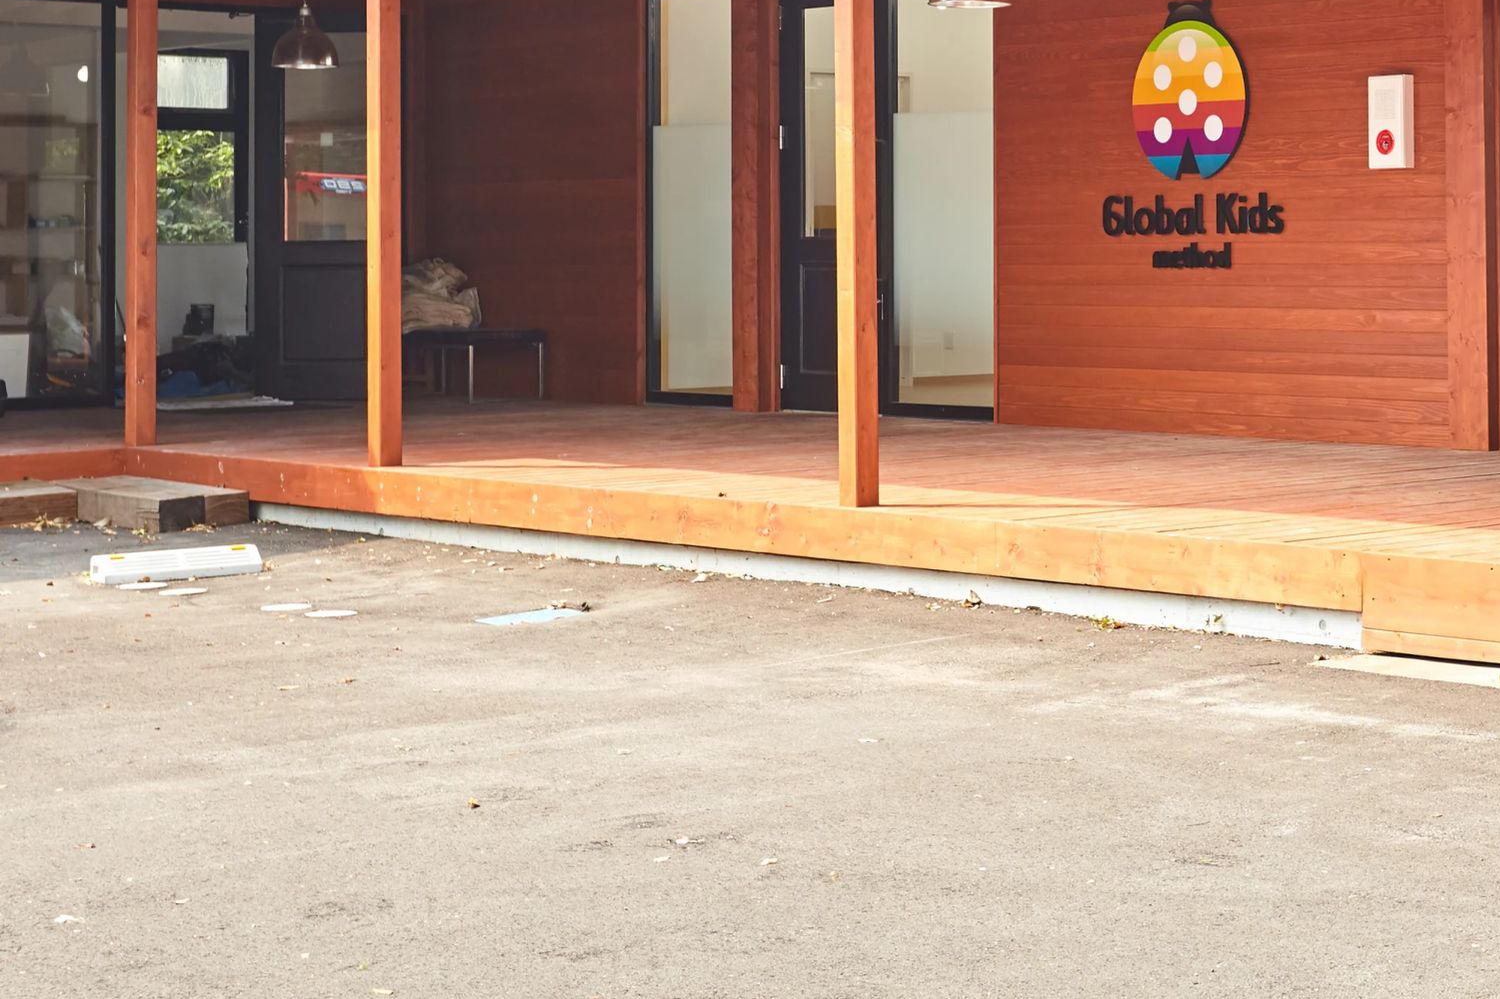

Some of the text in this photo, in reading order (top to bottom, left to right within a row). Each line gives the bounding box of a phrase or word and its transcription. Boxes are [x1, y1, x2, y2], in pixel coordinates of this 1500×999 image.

[1103, 192, 1284, 236] Global Kids
[1152, 242, 1232, 269] method
